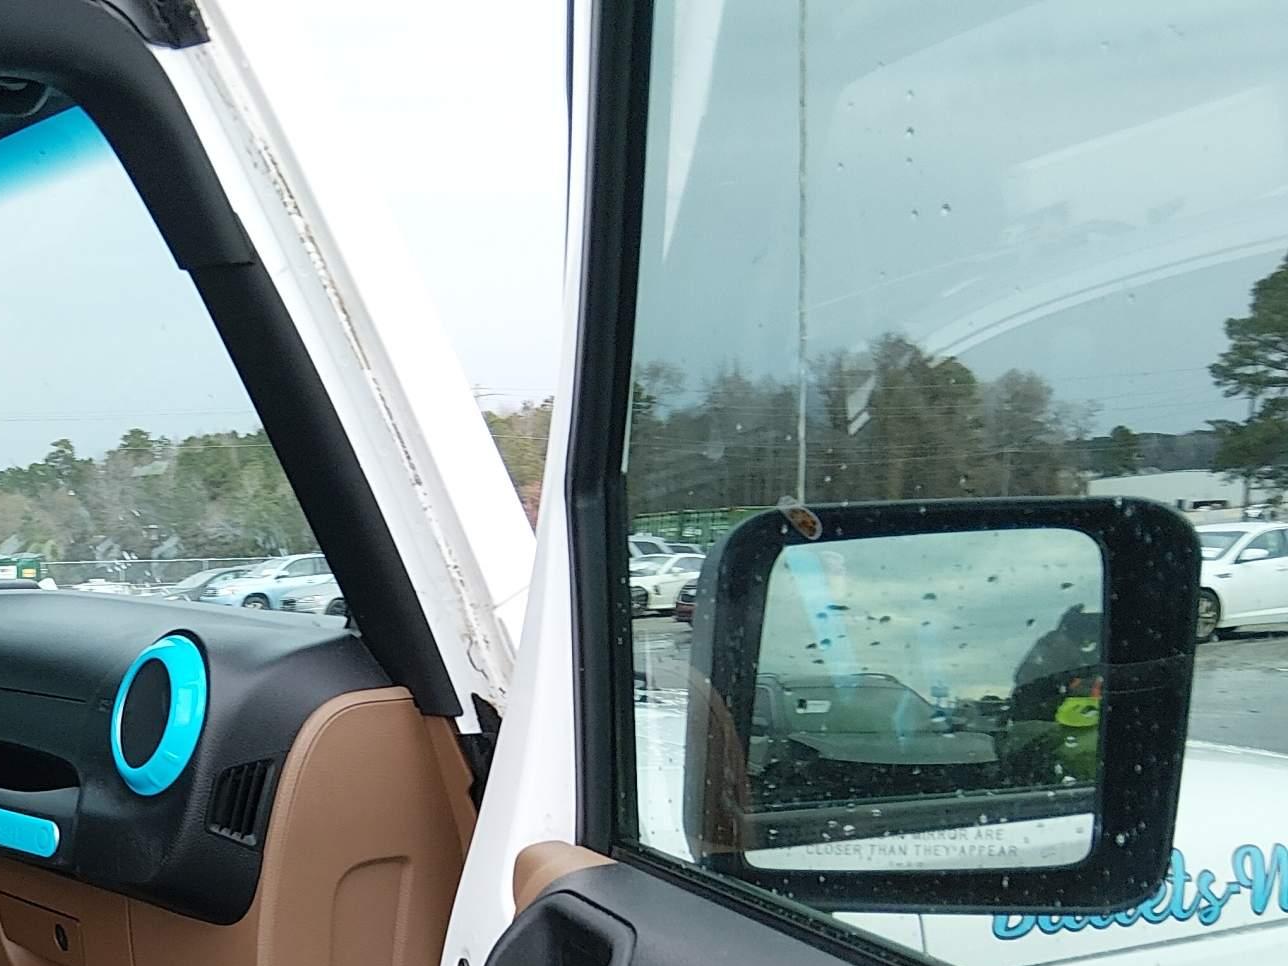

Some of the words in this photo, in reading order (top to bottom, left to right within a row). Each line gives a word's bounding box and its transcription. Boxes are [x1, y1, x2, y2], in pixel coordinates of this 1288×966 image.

[974, 828, 1006, 841] ARE
[805, 844, 862, 856] CLOSER
[869, 844, 907, 856] THAN
[913, 844, 950, 857] THEY
[958, 844, 1018, 857] APPEAR
